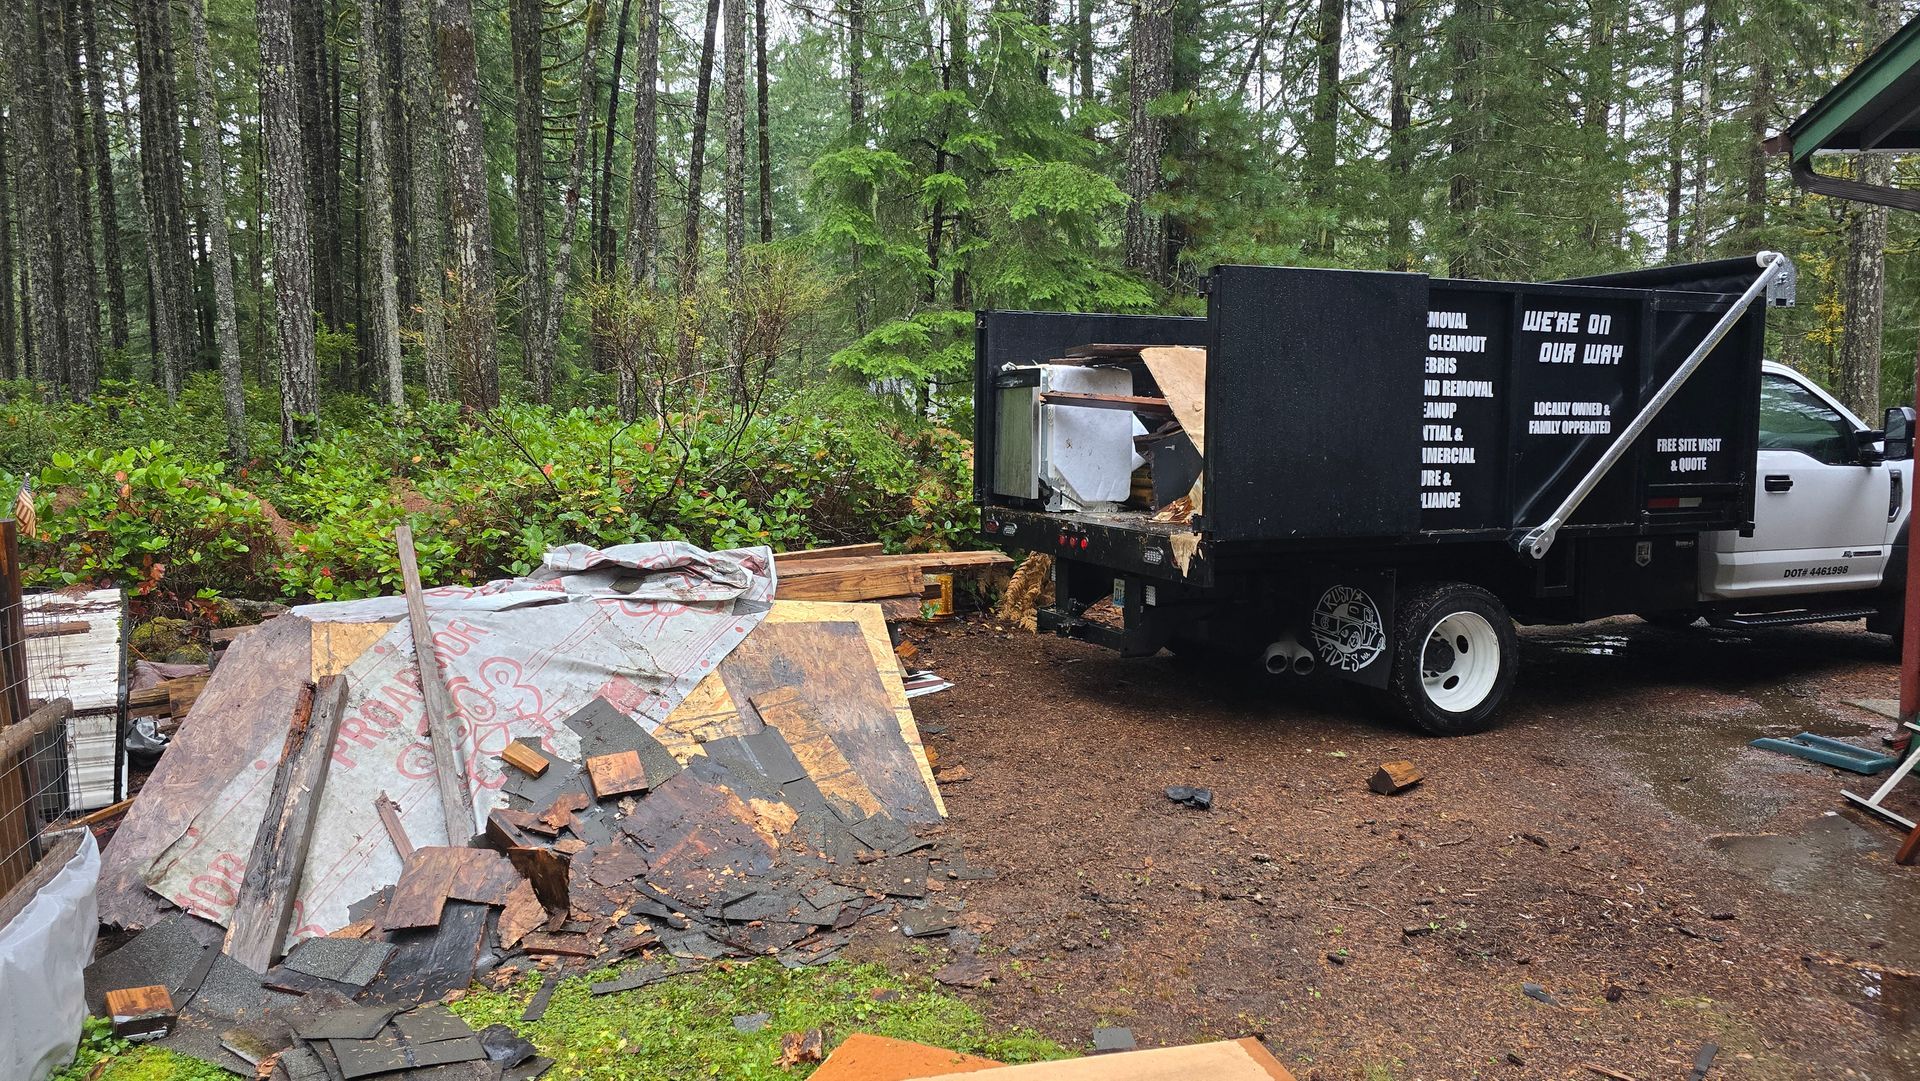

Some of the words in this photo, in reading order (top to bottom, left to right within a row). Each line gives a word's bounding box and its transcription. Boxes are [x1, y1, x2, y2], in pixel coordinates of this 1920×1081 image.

[1427, 311, 1468, 329] MOVAL
[1522, 311, 1581, 333] WE'RE
[1587, 314, 1612, 335] ON
[1428, 333, 1487, 353] CLEANOUT
[1539, 342, 1577, 363] OUR
[1582, 344, 1624, 365] WAY
[1442, 380, 1494, 398] REMOVAL
[1534, 401, 1571, 416] LOCALLY
[1571, 402, 1603, 416] OWNED
[1603, 404, 1611, 416] &
[1454, 427, 1464, 441] &
[1529, 420, 1561, 435] FAMILY
[1561, 420, 1611, 435] OPPERATED
[1657, 438, 1677, 452] FREE
[1678, 438, 1697, 452] SITE
[1698, 438, 1722, 452] VISIT
[1670, 459, 1678, 472] &
[1679, 457, 1707, 473] QUOTE
[1442, 472, 1452, 487] &
[1420, 492, 1461, 508] LIANCE
[1783, 568, 1808, 578] DOT#
[1809, 566, 1849, 576] 4461998
[1323, 587, 1357, 611] RUSTY
[1319, 642, 1360, 672] RIDES
